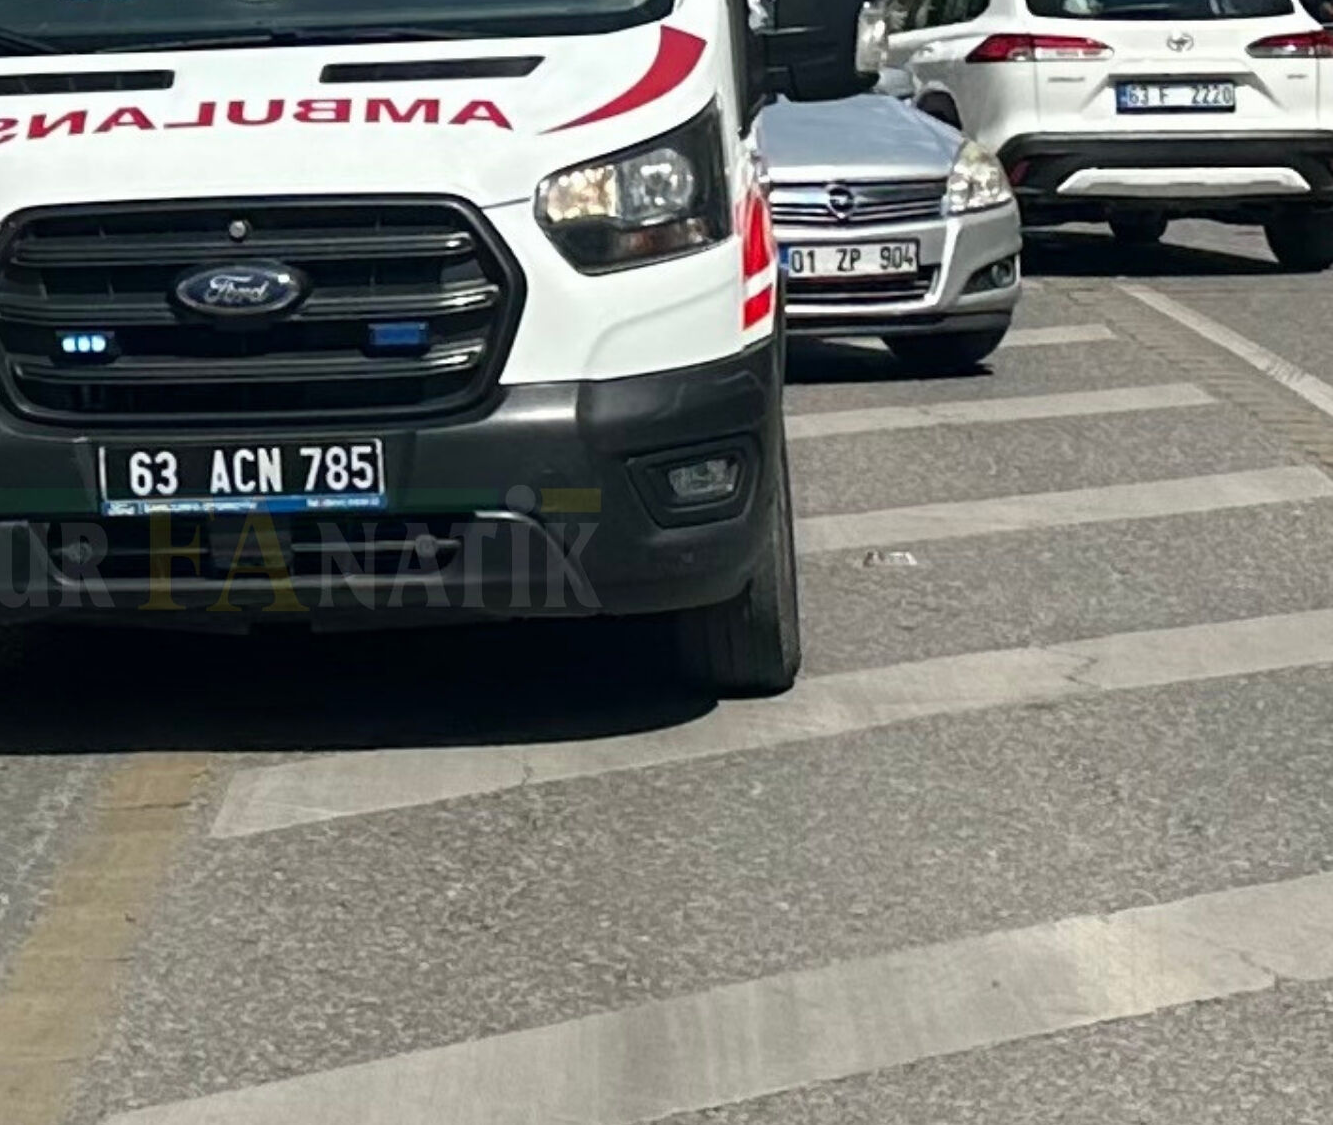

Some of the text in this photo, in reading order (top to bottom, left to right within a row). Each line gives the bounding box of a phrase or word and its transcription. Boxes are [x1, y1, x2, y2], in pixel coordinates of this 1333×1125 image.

[791, 243, 914, 274] 01 ZP 904
[203, 274, 270, 303] Ford
[129, 444, 375, 496] 63 ACN 785
